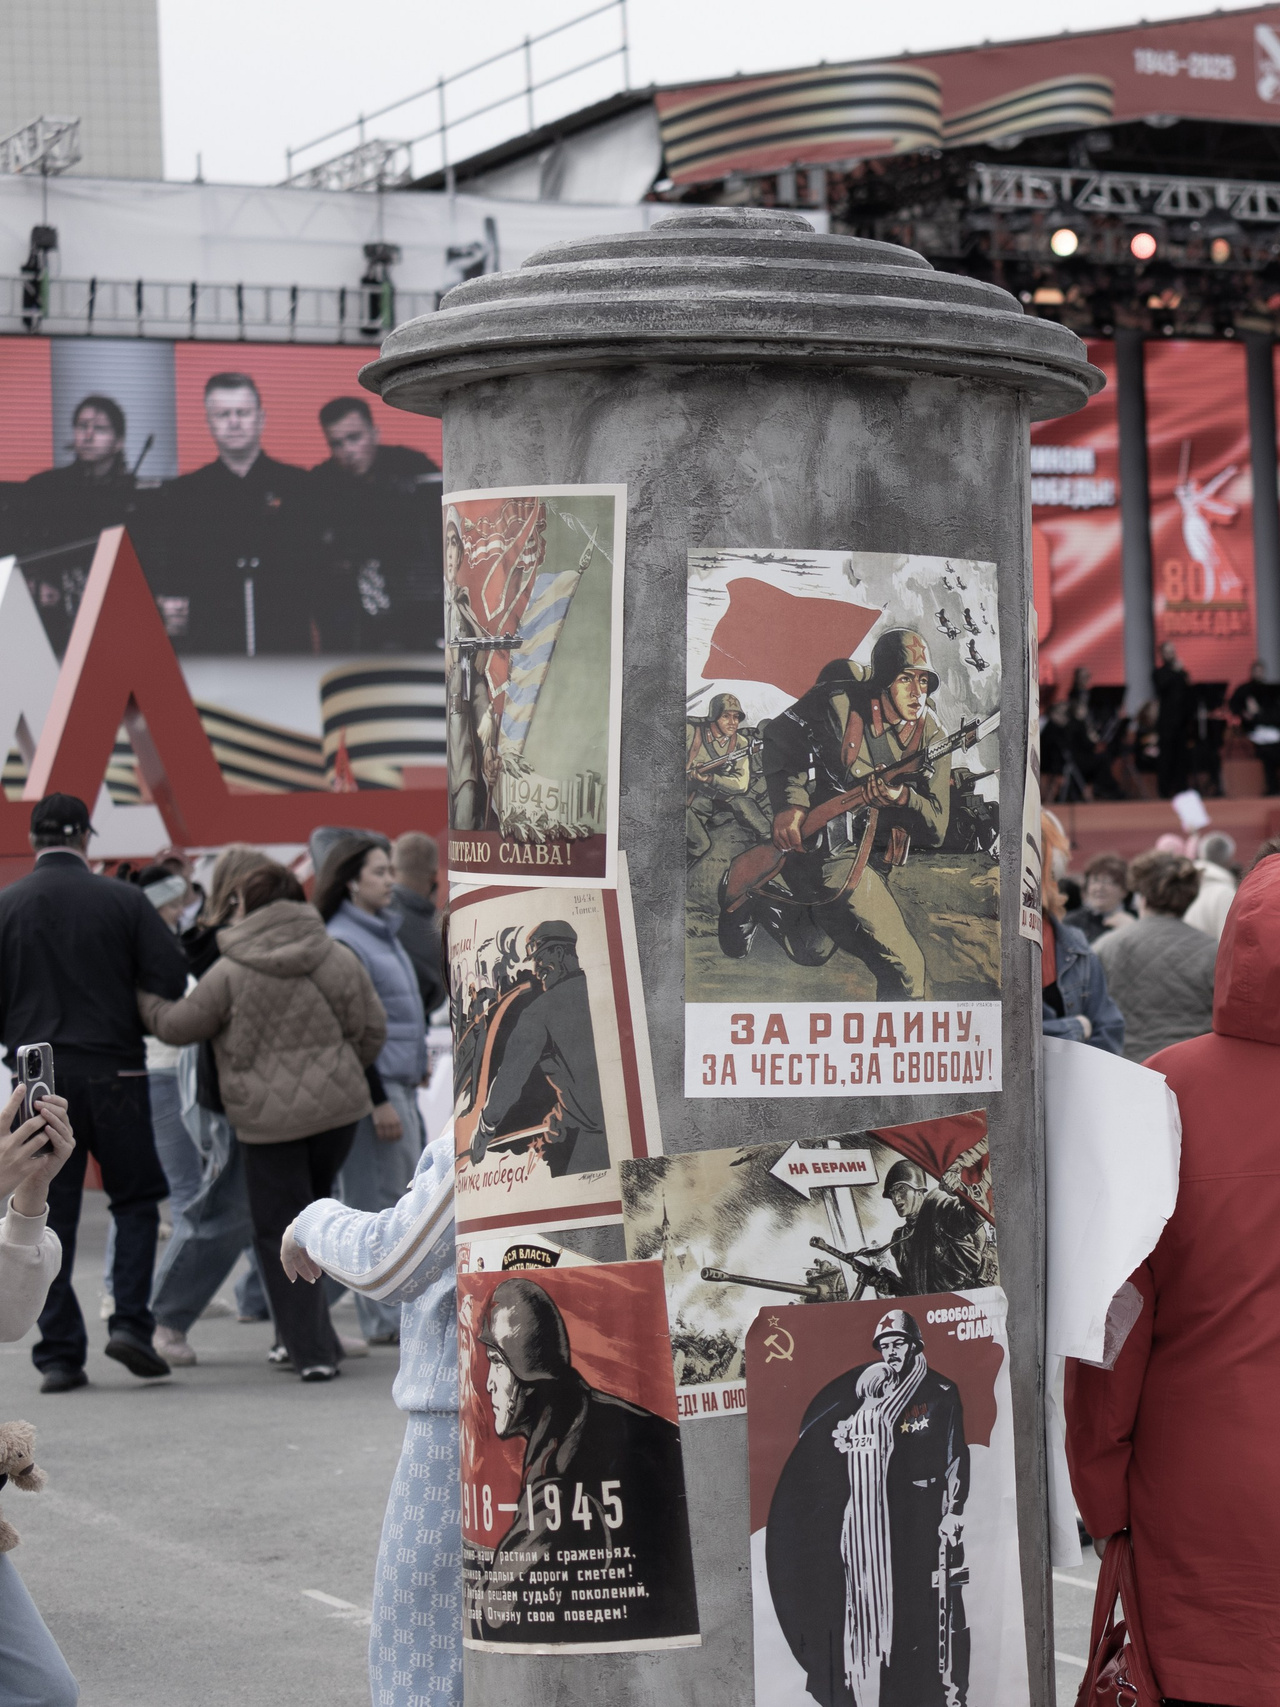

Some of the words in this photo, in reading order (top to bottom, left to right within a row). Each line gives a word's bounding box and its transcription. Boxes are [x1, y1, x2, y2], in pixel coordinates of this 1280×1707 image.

[500, 842, 572, 866] СЛАВА!
[730, 1012, 790, 1046] ЗА
[809, 1010, 982, 1048] РОДИНУ,
[702, 1052, 737, 1086] ЗА
[892, 1048, 993, 1085] СВОБОДУ!
[788, 1162, 809, 1175] НА
[811, 1161, 867, 1174] БЕРЛИН
[504, 1249, 517, 1265] ВСЯ
[519, 1248, 552, 1264] ВЛАСТЬ
[702, 1391, 719, 1412] НА
[722, 1388, 747, 1409] ОКО
[500, 1551, 538, 1565] растили
[557, 1546, 637, 1565] сраженьях,
[519, 1571, 525, 1581] с
[529, 1570, 569, 1584] дороги
[577, 1563, 633, 1582] сметем!
[488, 1590, 518, 1602] решаем
[523, 1587, 562, 1605] судьбу
[571, 1582, 650, 1601] поколений,
[487, 1607, 521, 1625] Отчизну
[527, 1610, 555, 1622] свою
[564, 1605, 628, 1623] поведем!
